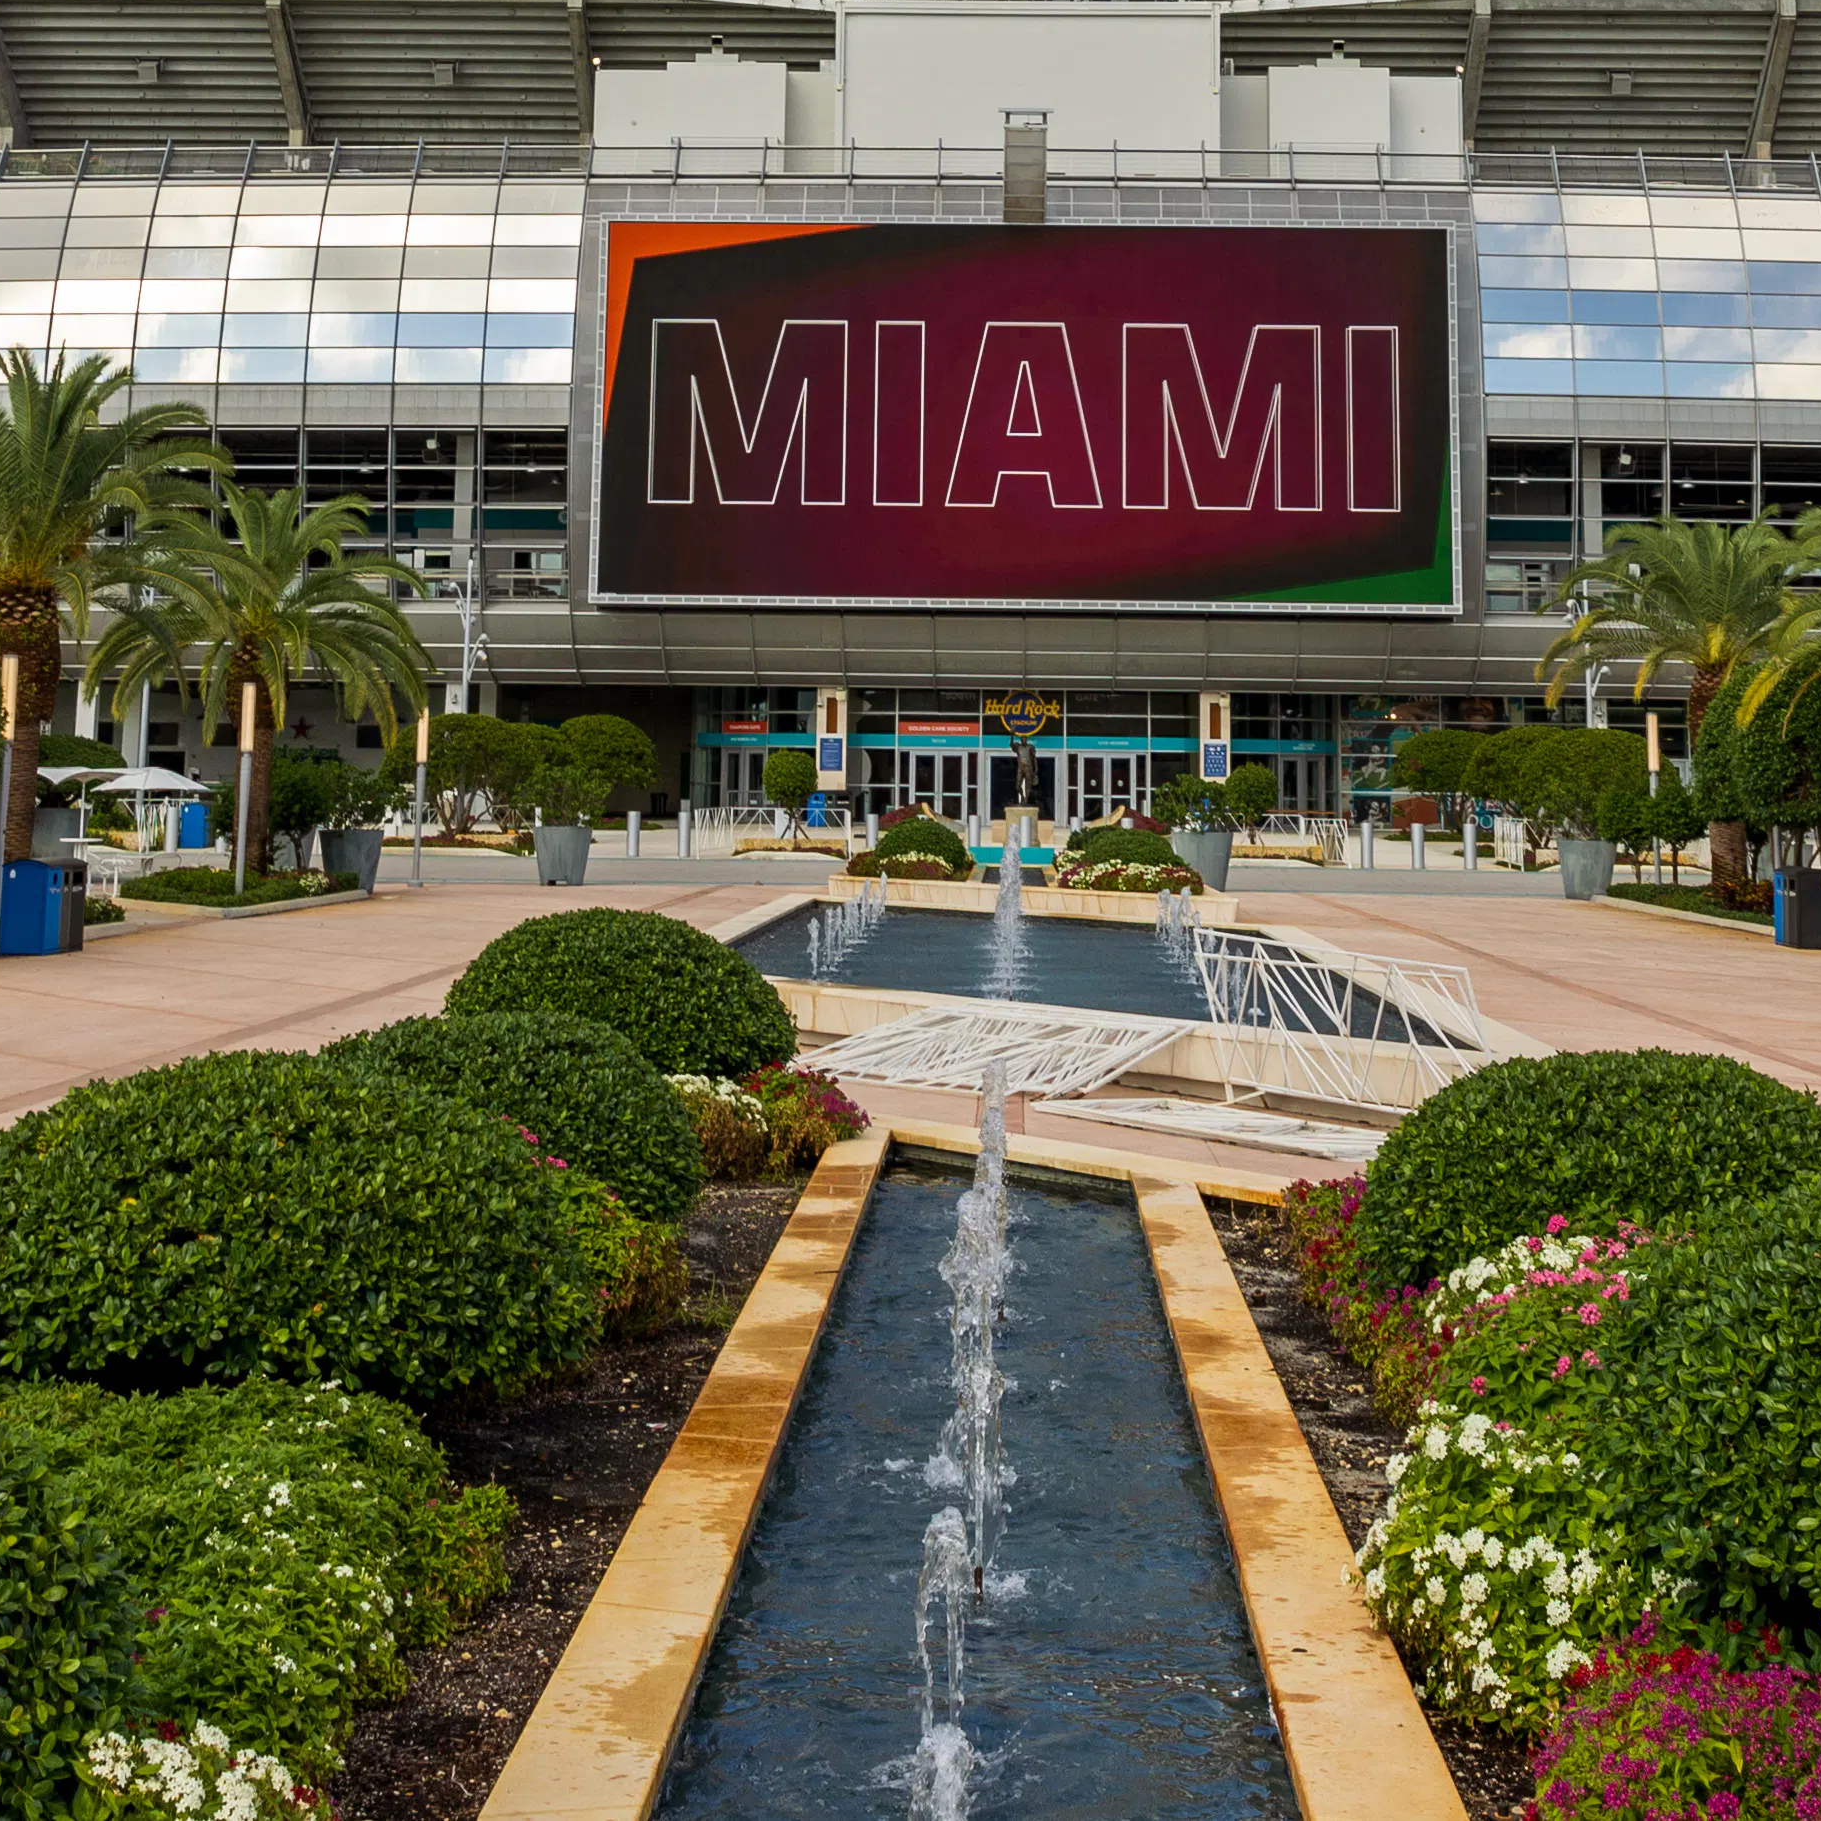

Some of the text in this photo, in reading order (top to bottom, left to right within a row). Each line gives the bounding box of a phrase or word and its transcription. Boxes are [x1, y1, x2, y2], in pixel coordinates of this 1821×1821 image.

[647, 318, 1401, 512] MIAMI
[984, 698, 1060, 719] Hard Rock
